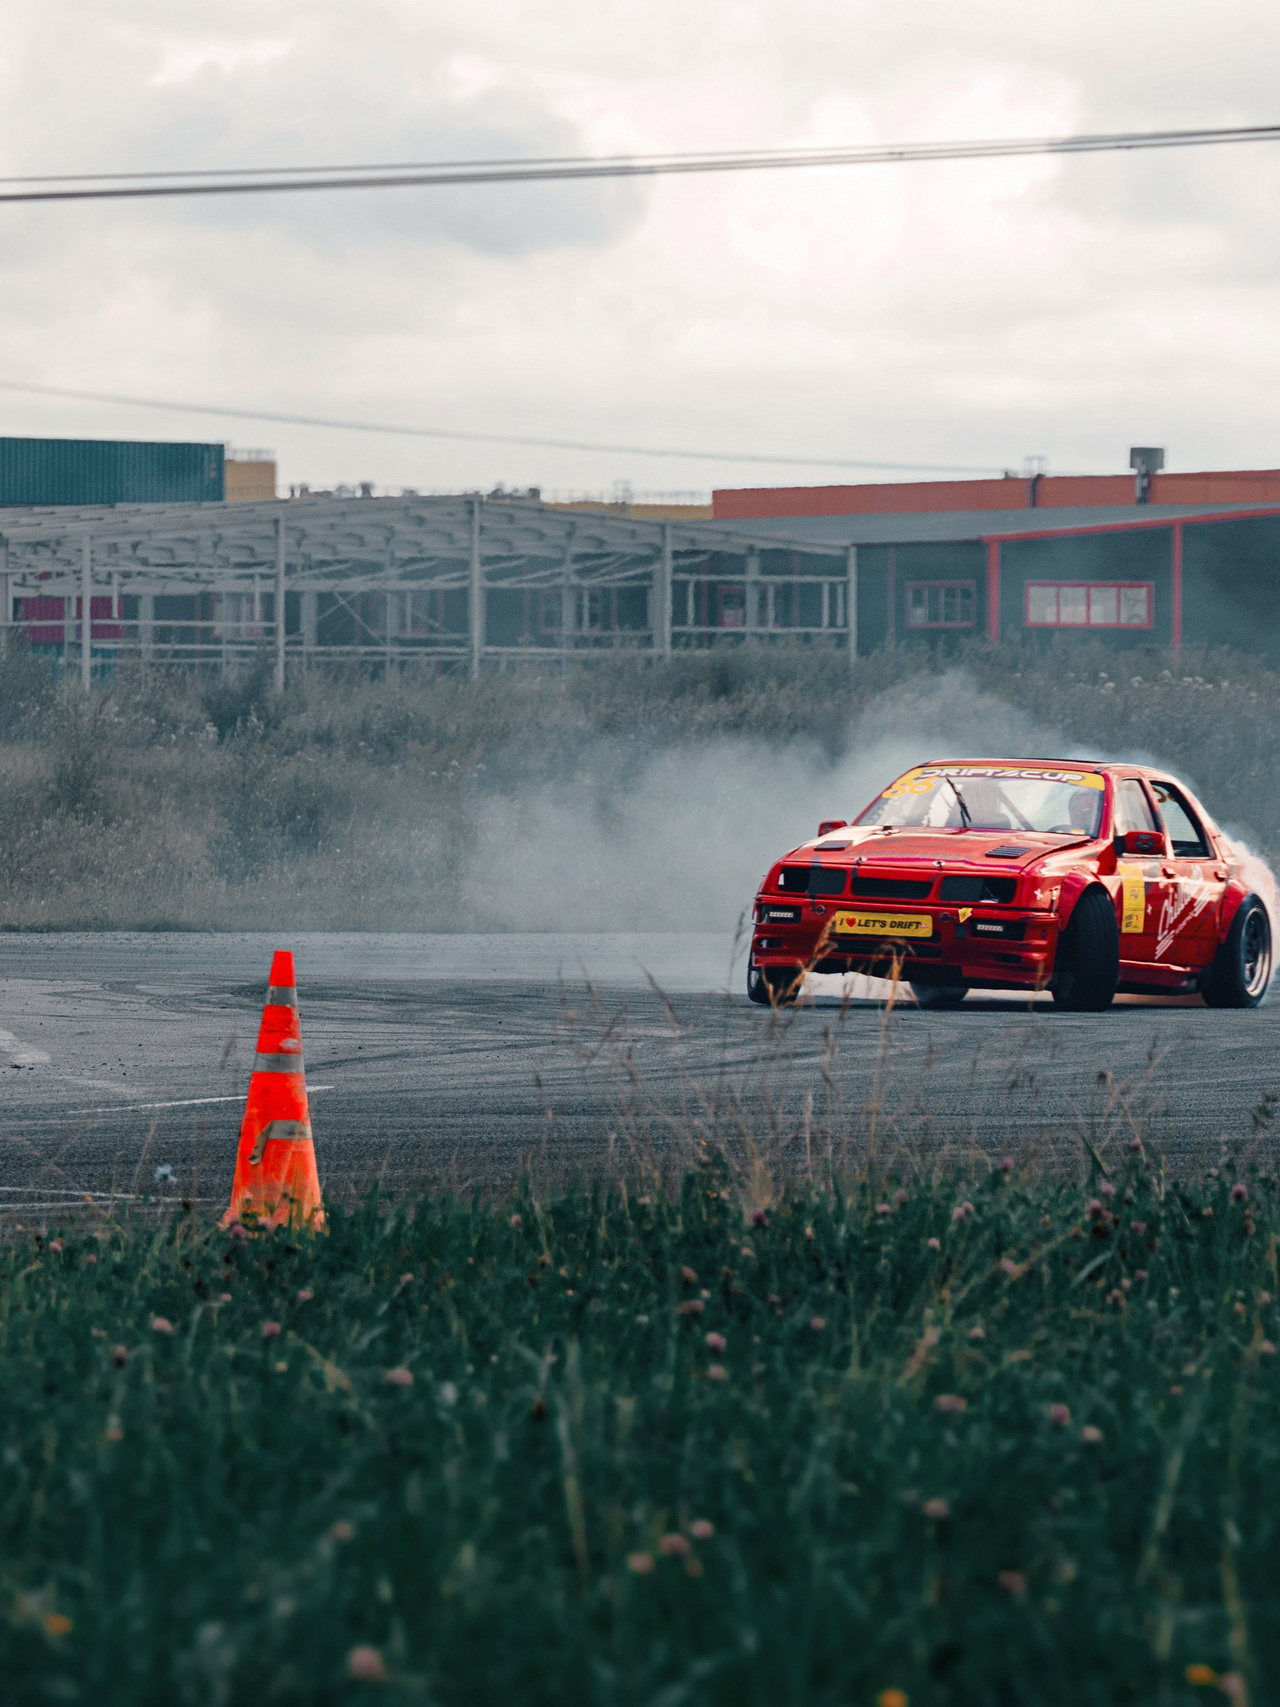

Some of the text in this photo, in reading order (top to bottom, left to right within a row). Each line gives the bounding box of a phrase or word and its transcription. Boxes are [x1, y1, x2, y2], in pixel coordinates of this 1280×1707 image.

[882, 776, 939, 799] 86
[838, 918, 844, 926] I
[857, 919, 888, 928] LET'S
